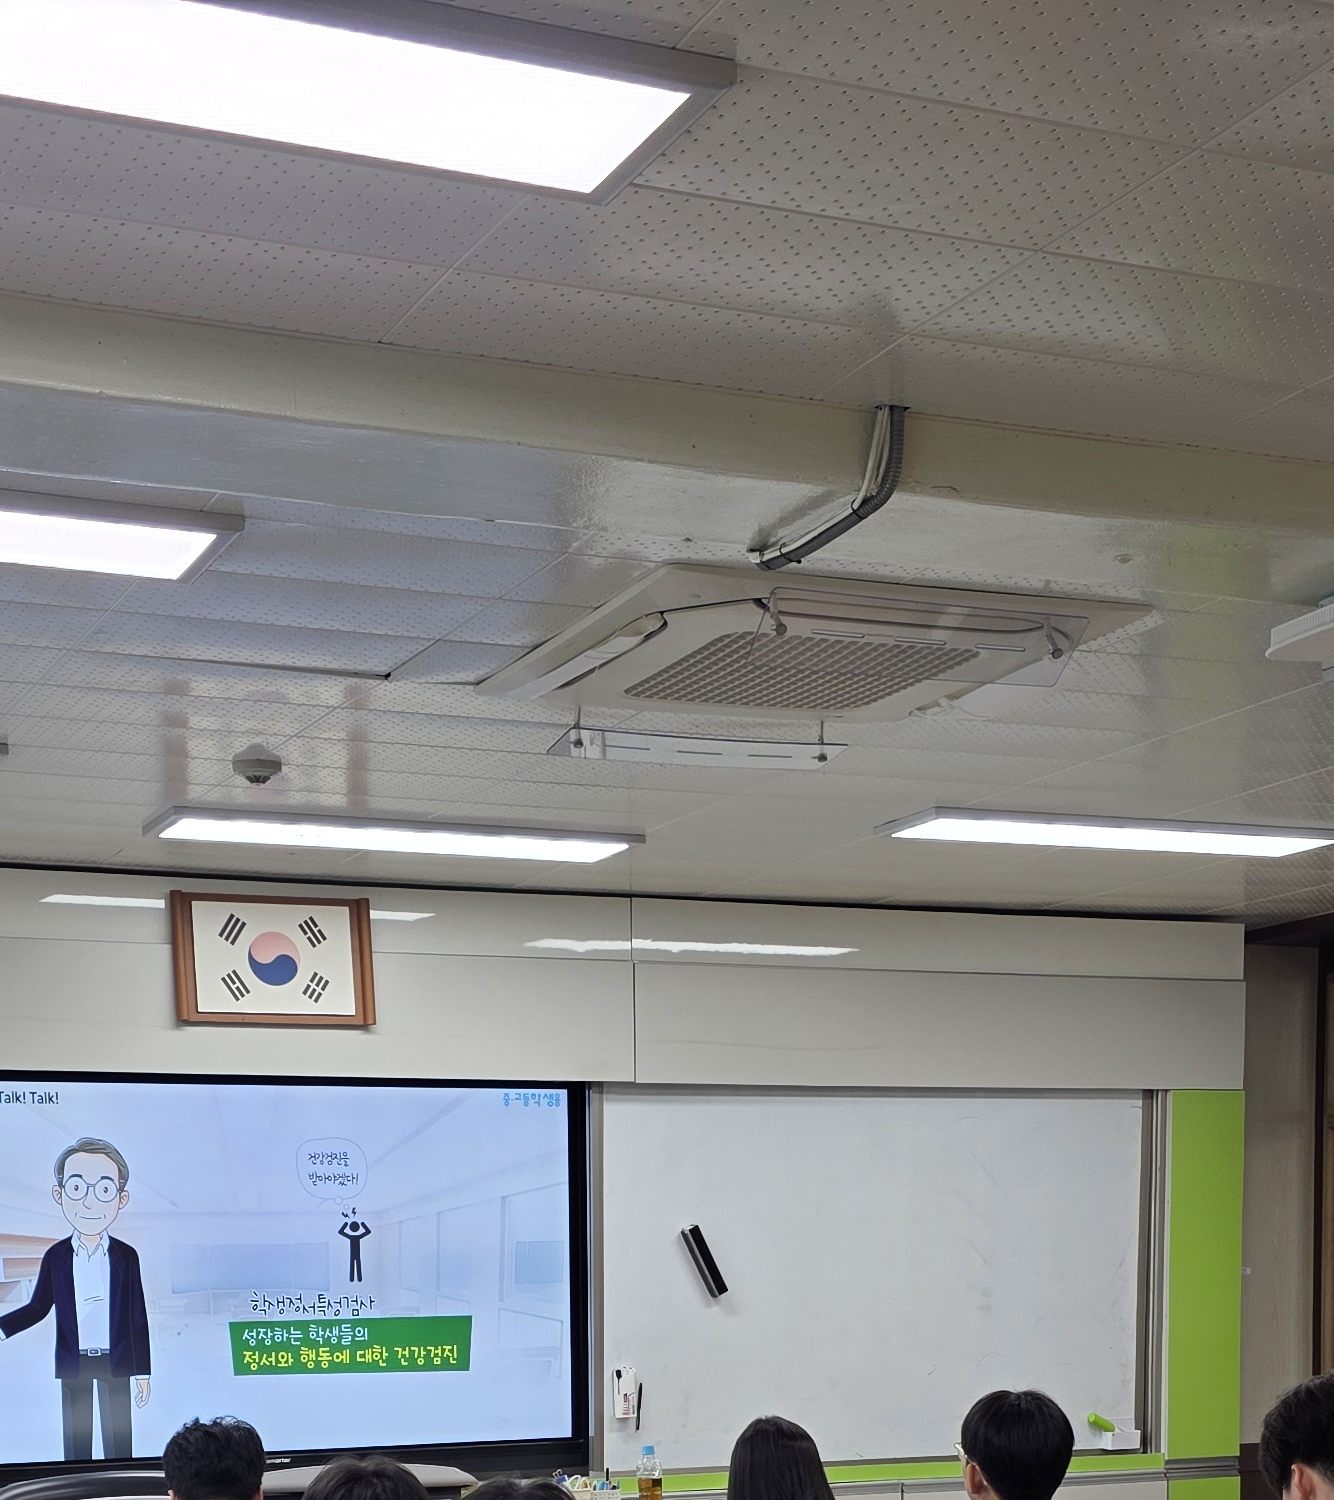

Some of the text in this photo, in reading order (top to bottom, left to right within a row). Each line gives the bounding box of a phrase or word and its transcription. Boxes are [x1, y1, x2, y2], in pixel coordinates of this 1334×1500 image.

[29, 1091, 59, 1105] Talk!
[307, 1151, 350, 1167] 건강검진을
[308, 1172, 359, 1187] 받아야겠다!
[249, 1290, 376, 1317] 학생정서특성검사
[242, 1324, 368, 1346] 성장하는 학생들의
[242, 1344, 458, 1371] 정서와 행동에 대한 건강검진
